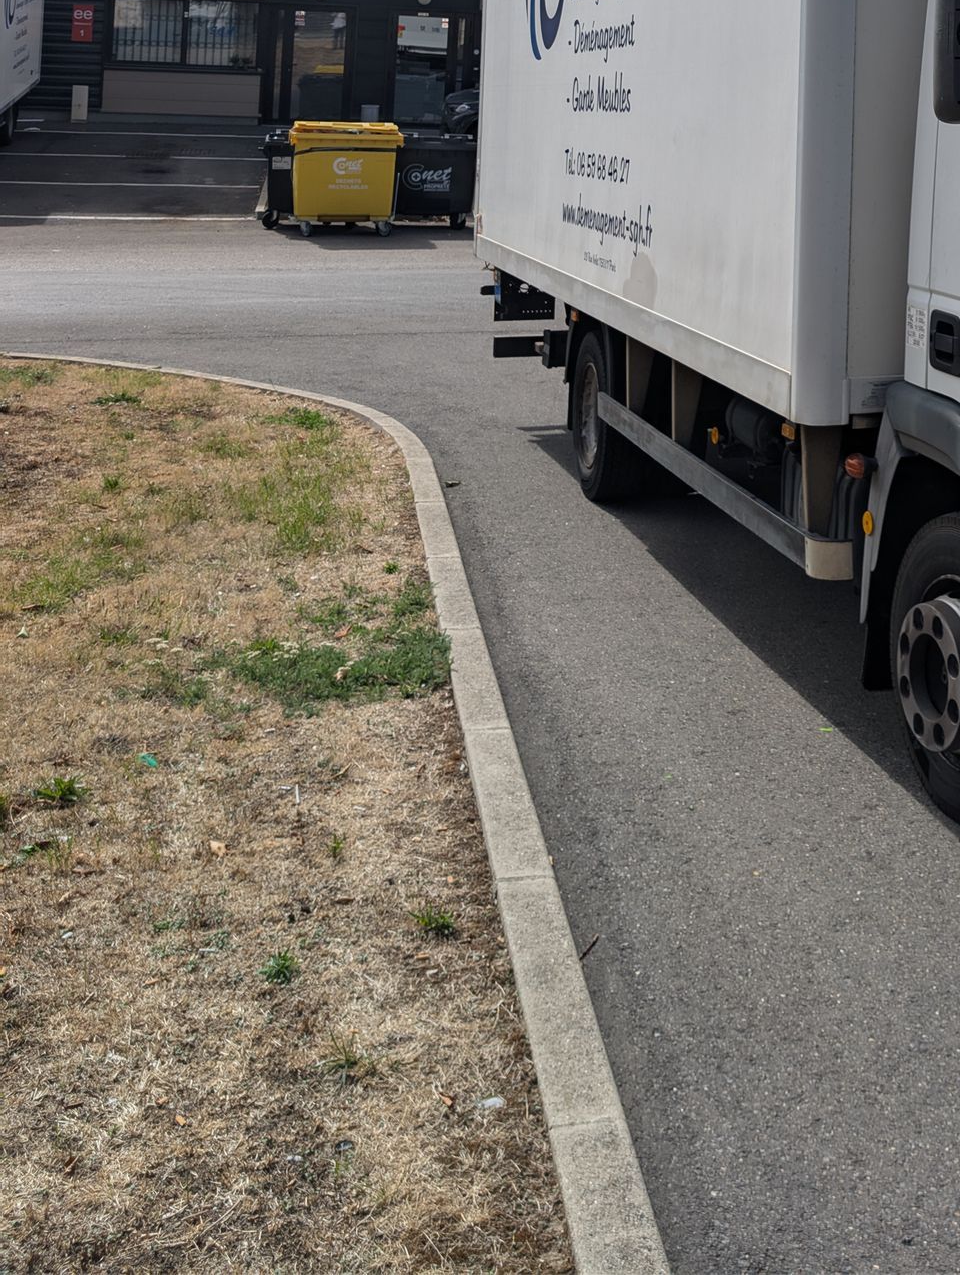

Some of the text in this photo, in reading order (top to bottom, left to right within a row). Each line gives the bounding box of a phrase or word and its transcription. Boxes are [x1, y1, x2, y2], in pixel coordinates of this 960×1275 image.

[79, 29, 85, 37] 1
[574, 14, 635, 64] Déménagement
[572, 74, 594, 113] Garde
[597, 71, 631, 113] Meubles
[577, 151, 586, 177] 06
[587, 153, 596, 179] 59
[597, 154, 606, 181] 68
[608, 155, 618, 183] 46
[620, 157, 630, 184] 27
[562, 192, 653, 257] www.demenagement-sgh.fr
